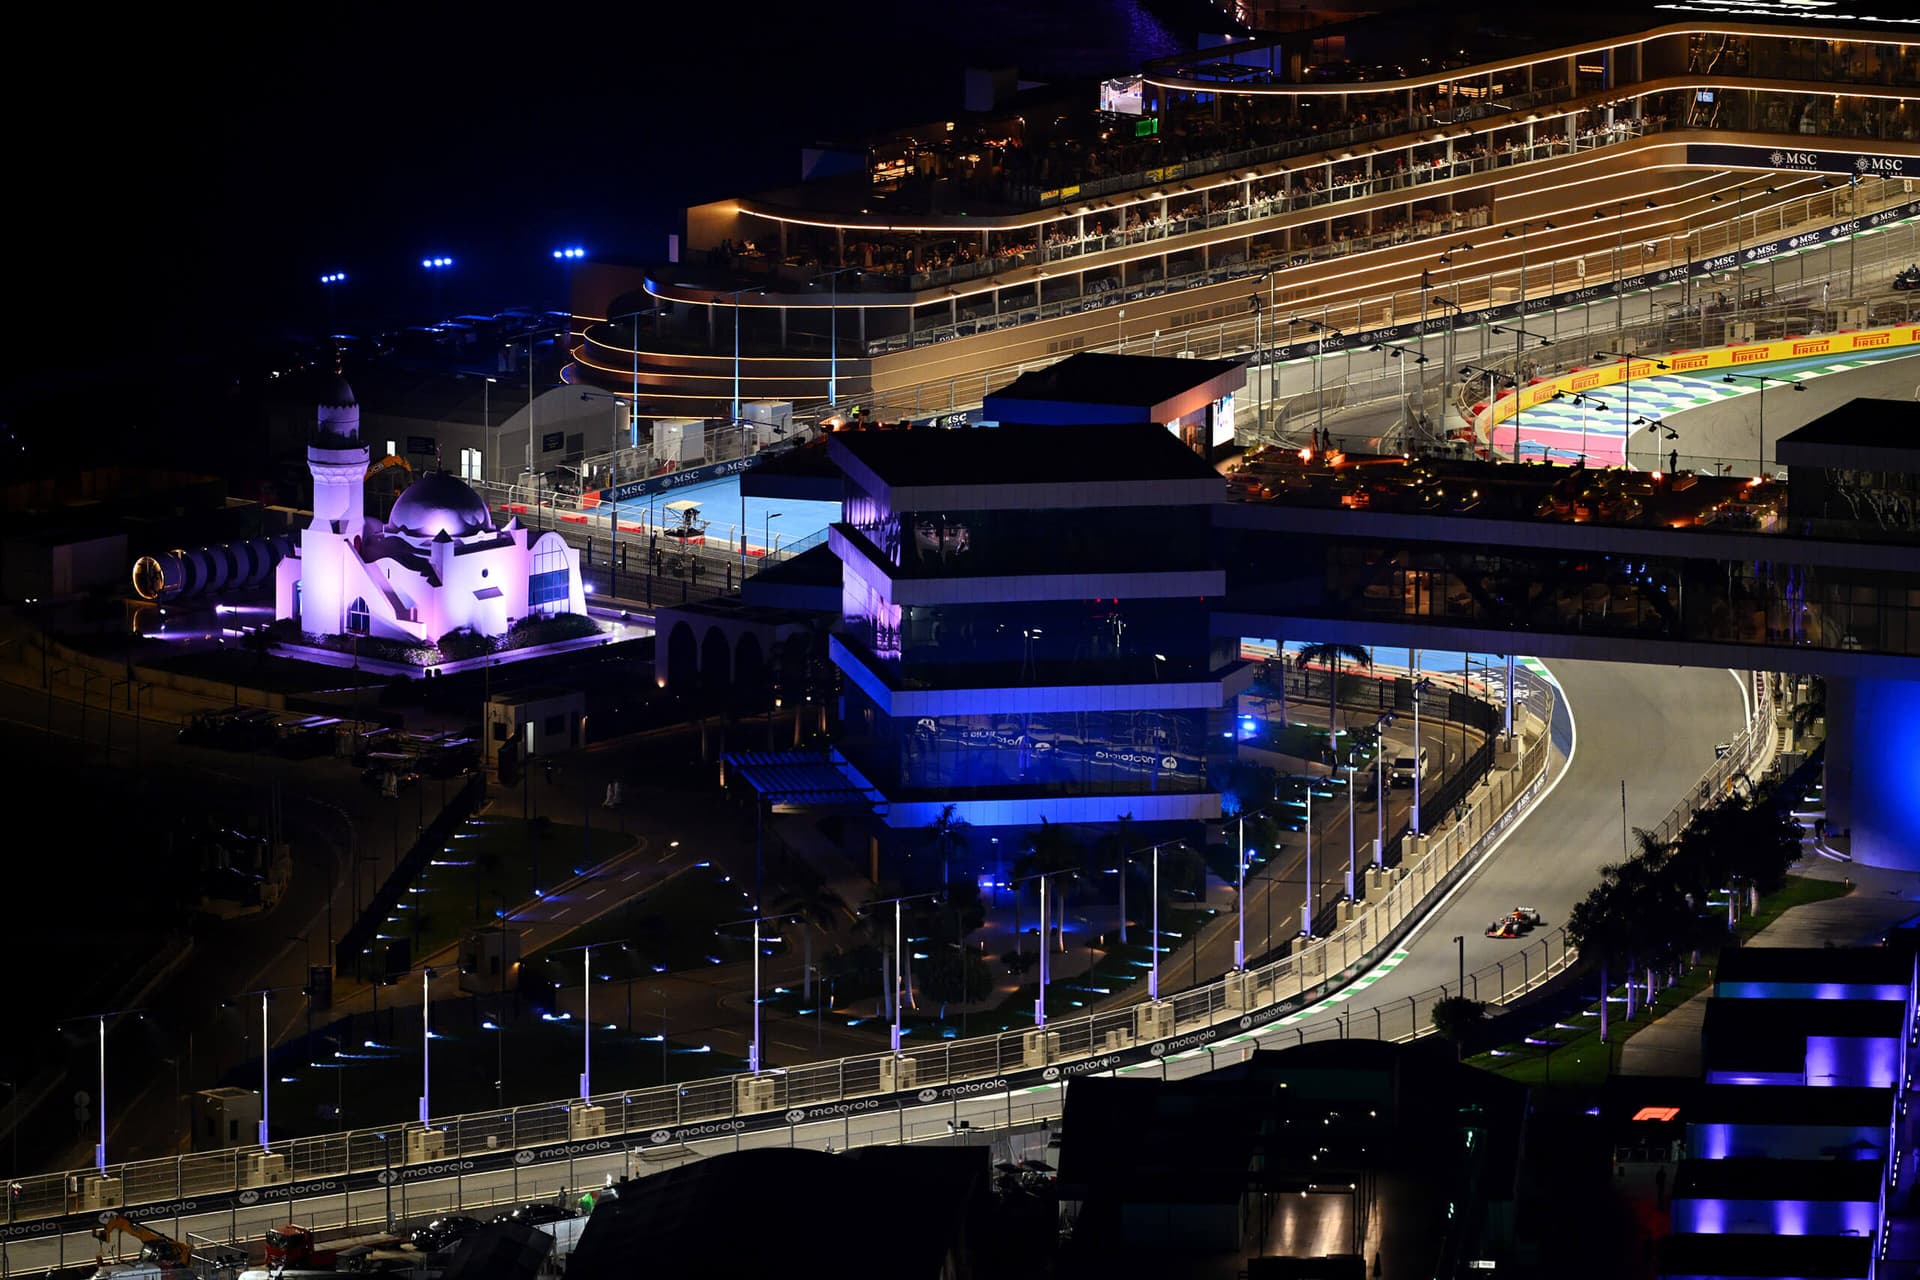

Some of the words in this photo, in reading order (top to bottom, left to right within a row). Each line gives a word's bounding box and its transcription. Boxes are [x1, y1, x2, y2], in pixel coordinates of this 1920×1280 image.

[1786, 152, 1817, 166] MSC
[1871, 158, 1903, 171] MSC
[1880, 209, 1899, 221] MSC
[1800, 232, 1820, 243] MSC
[1756, 243, 1778, 256] MSC
[1714, 255, 1735, 267] MSC
[1623, 277, 1646, 289] MSC
[1575, 288, 1598, 300] MSC
[1527, 299, 1550, 310] MSC
[1372, 329, 1398, 341] MSC
[1853, 333, 1890, 348] PIRELLI
[1319, 338, 1345, 350] MSC
[1792, 339, 1830, 355] PIRELLI
[1672, 354, 1708, 371] PIRELLI
[1732, 347, 1769, 363] PIRELLI
[1571, 373, 1600, 390] PIRELLI
[727, 459, 753, 473] MSC
[674, 470, 700, 484] MSC
[621, 482, 646, 497] MSC
[1253, 1001, 1293, 1024] motorola
[1168, 1030, 1216, 1050] motorola
[942, 1078, 1008, 1097] motorola
[809, 1099, 879, 1118] motorola
[675, 1119, 745, 1138] motorola
[539, 1141, 611, 1159] motorola
[402, 1159, 474, 1179] motorola
[264, 1180, 336, 1199] motorola
[123, 1200, 197, 1218] motorola
